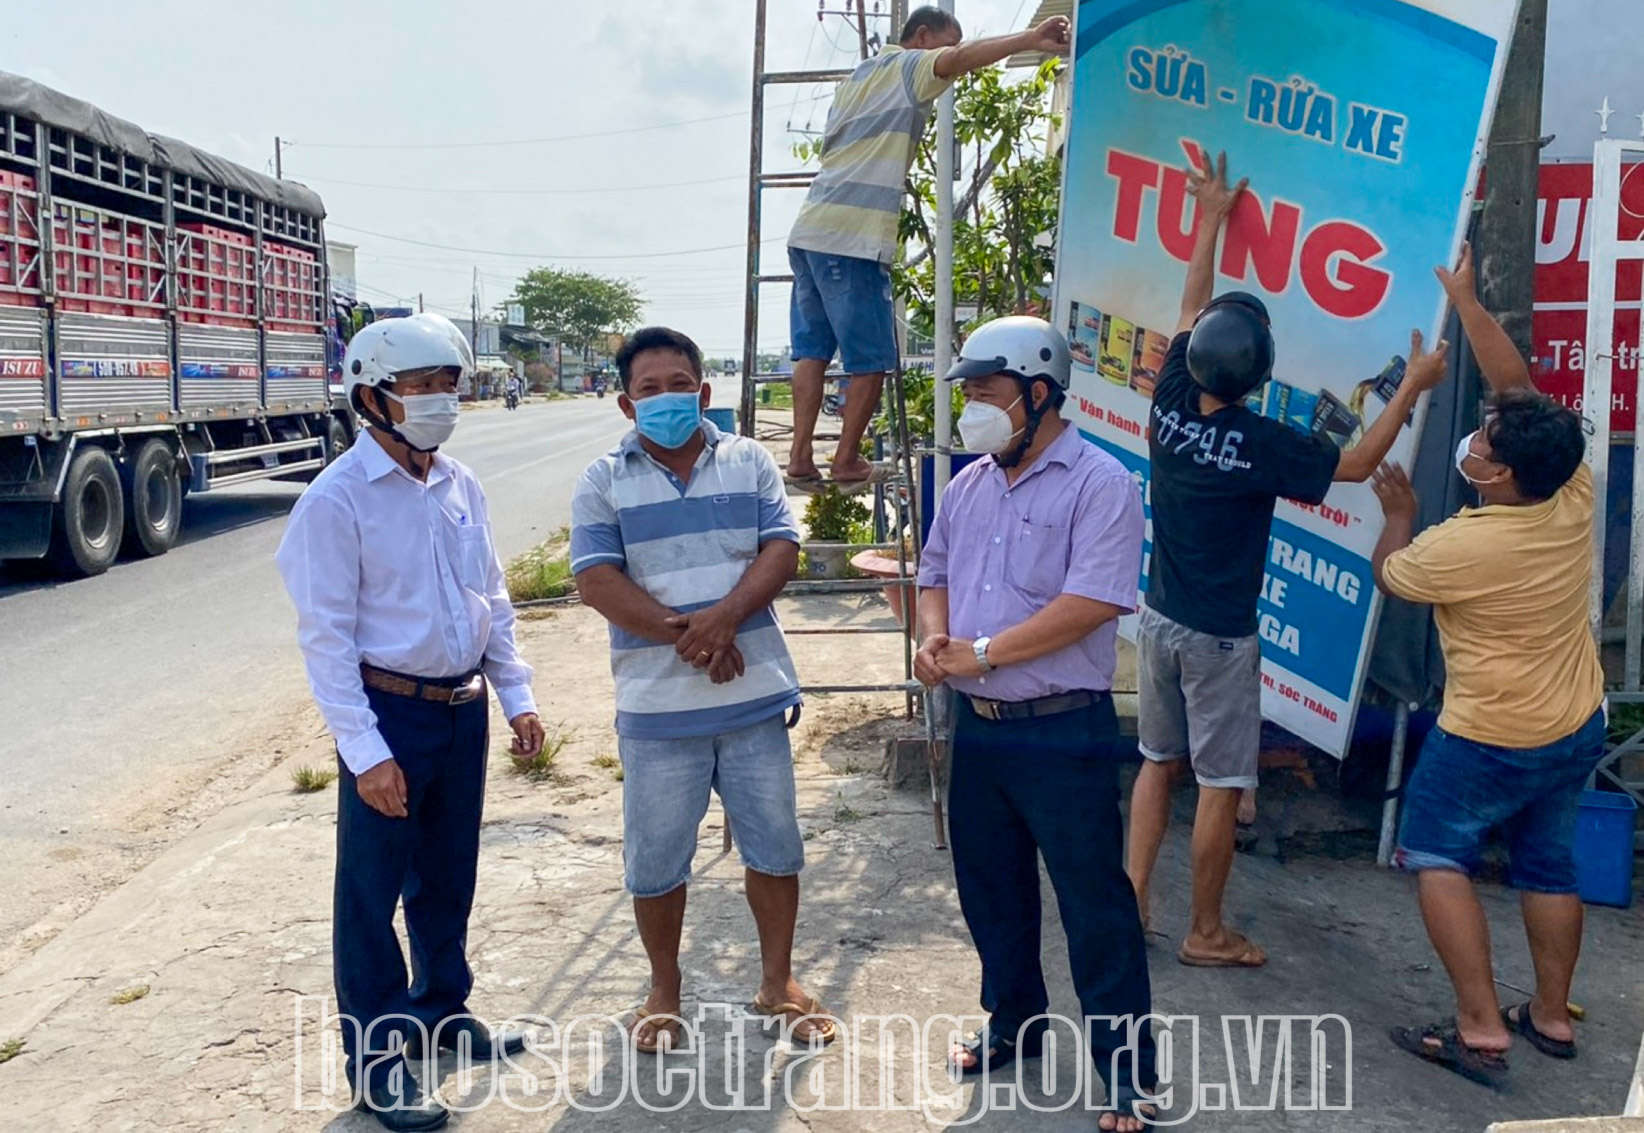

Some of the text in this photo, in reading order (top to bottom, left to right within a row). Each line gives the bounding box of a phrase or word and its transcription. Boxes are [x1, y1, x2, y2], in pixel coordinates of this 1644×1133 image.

[1128, 45, 1206, 107] SỬA
[1246, 77, 1334, 143] RỬA
[1345, 104, 1405, 161] XE
[1106, 138, 1390, 319] TÙNG
[2, 360, 39, 375] ISUZU
[1268, 535, 1361, 606] RANG
